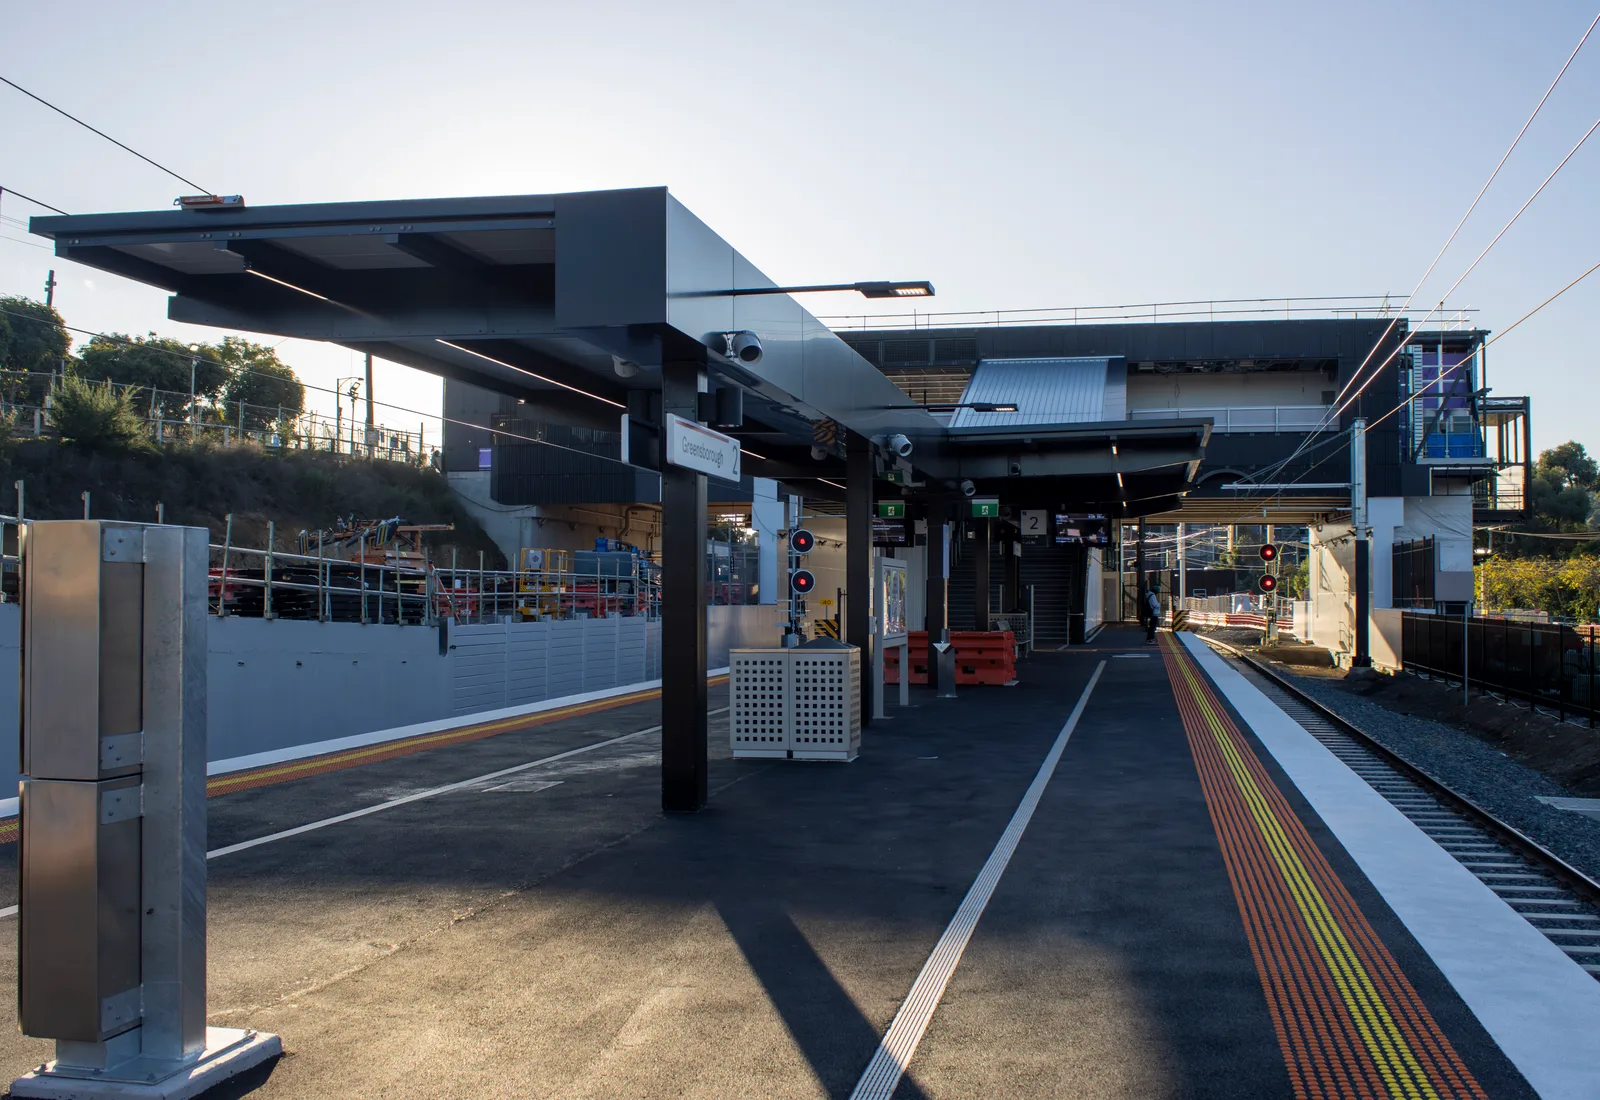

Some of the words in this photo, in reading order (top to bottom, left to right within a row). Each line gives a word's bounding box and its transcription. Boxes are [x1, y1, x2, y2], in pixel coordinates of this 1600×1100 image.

[682, 435, 724, 469] Greensborough
[732, 444, 738, 476] 2
[1029, 516, 1039, 530] 2
